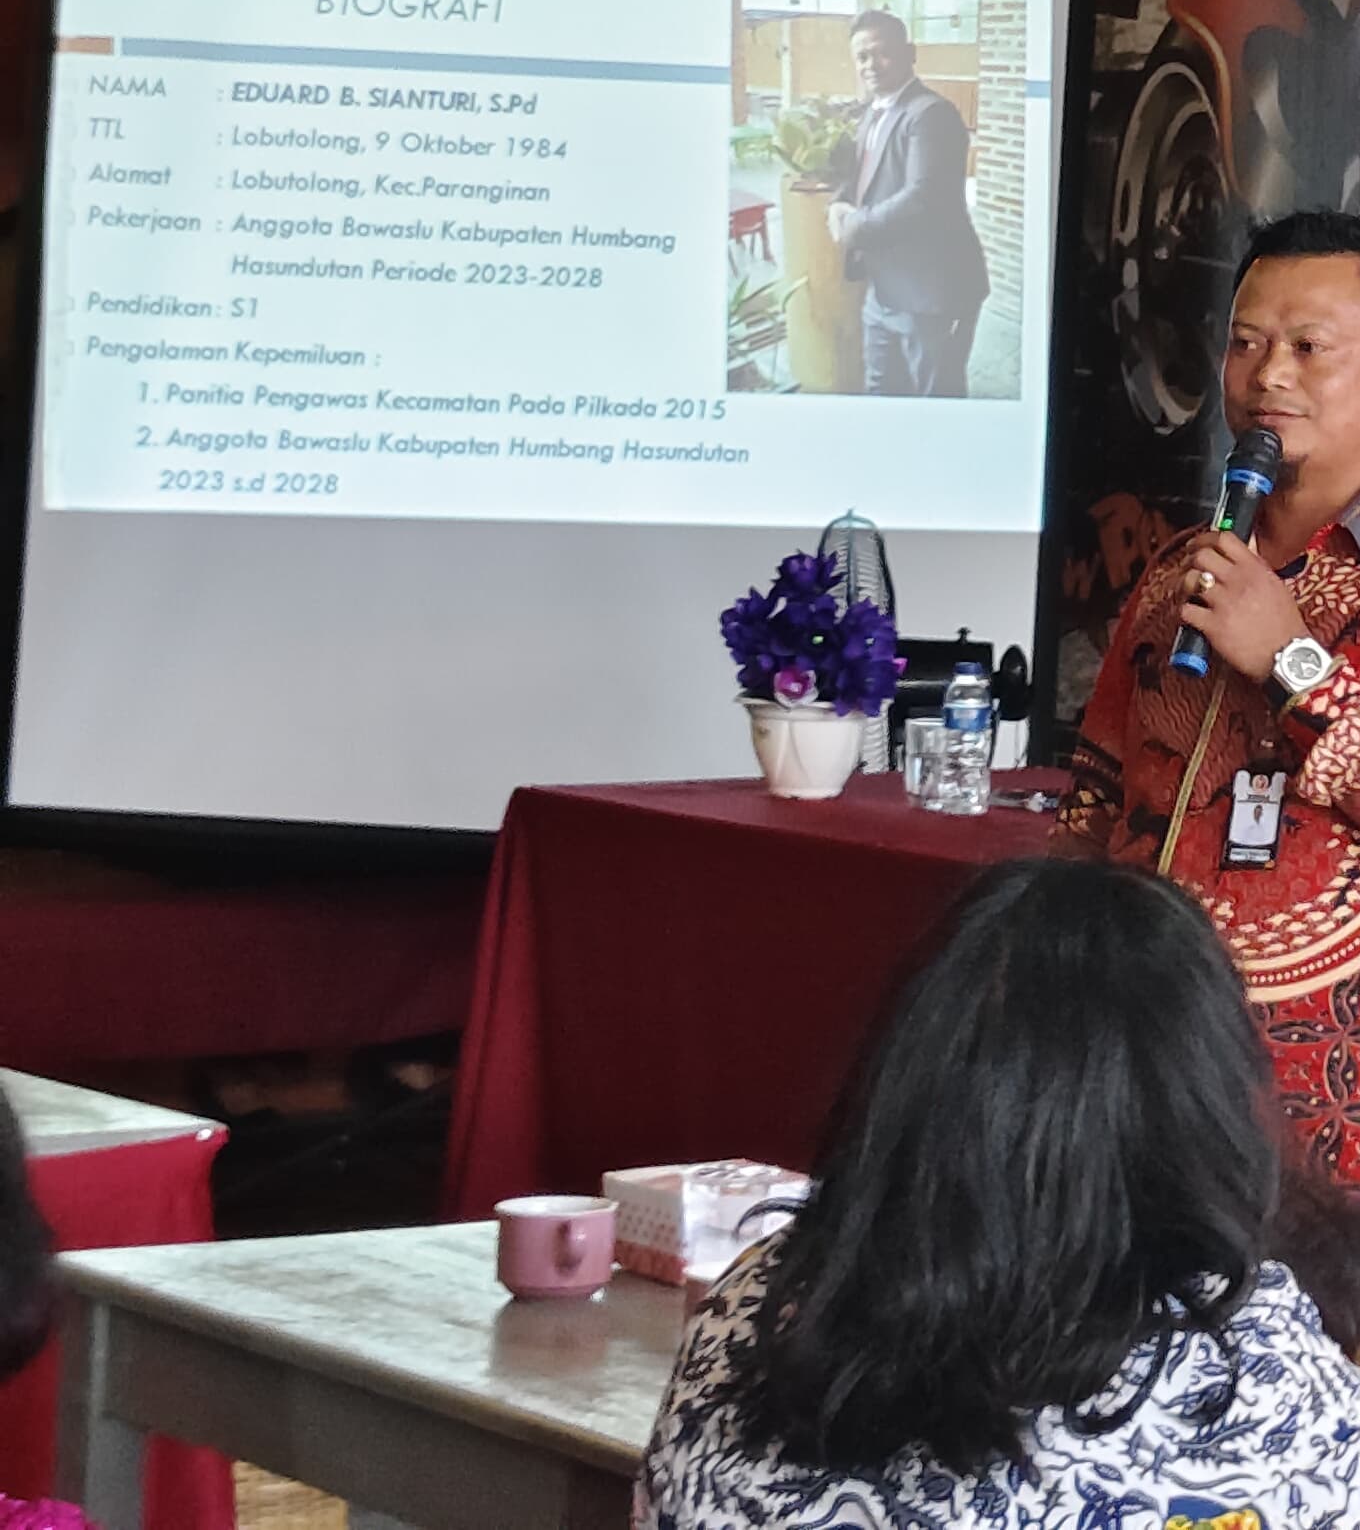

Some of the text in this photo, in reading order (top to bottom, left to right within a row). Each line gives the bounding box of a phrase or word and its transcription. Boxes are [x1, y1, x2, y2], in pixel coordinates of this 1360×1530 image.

[88, 75, 167, 97] NAMA
[231, 81, 330, 104] EDUARD
[339, 86, 361, 107] B.
[368, 87, 482, 114] SIANTURI,
[89, 117, 125, 140] TTL
[231, 125, 366, 155] Lobutolong,
[375, 130, 390, 150] 9
[400, 131, 496, 157] Oktober
[507, 136, 569, 159] 1984
[88, 163, 171, 186] Alamat
[231, 169, 365, 198] Lobutolong,
[87, 205, 201, 234] Pekerjaan
[231, 213, 333, 239] Anggota
[342, 216, 434, 240] Bawaslu
[441, 220, 562, 247] Kabupaten
[571, 224, 677, 255] Humbang
[231, 254, 602, 289] Hasundutan Periode 2023-2028
[231, 297, 259, 318] S1
[87, 336, 228, 364] Pengalaman
[234, 341, 365, 366] Kepemiluan
[166, 383, 244, 406] Panitia
[252, 385, 367, 411] Pengawas
[375, 389, 500, 413] Kecamatan
[508, 393, 565, 415] Pada
[573, 395, 657, 418] Pilkada
[664, 398, 727, 419] 2015
[166, 427, 268, 453] Anggota
[278, 430, 371, 452] Bawaslu
[377, 433, 499, 458] Kabupaten
[508, 437, 614, 464] Humbang
[623, 439, 749, 463] Hasundutan
[159, 470, 224, 492] 2023
[273, 472, 339, 494] 2028
